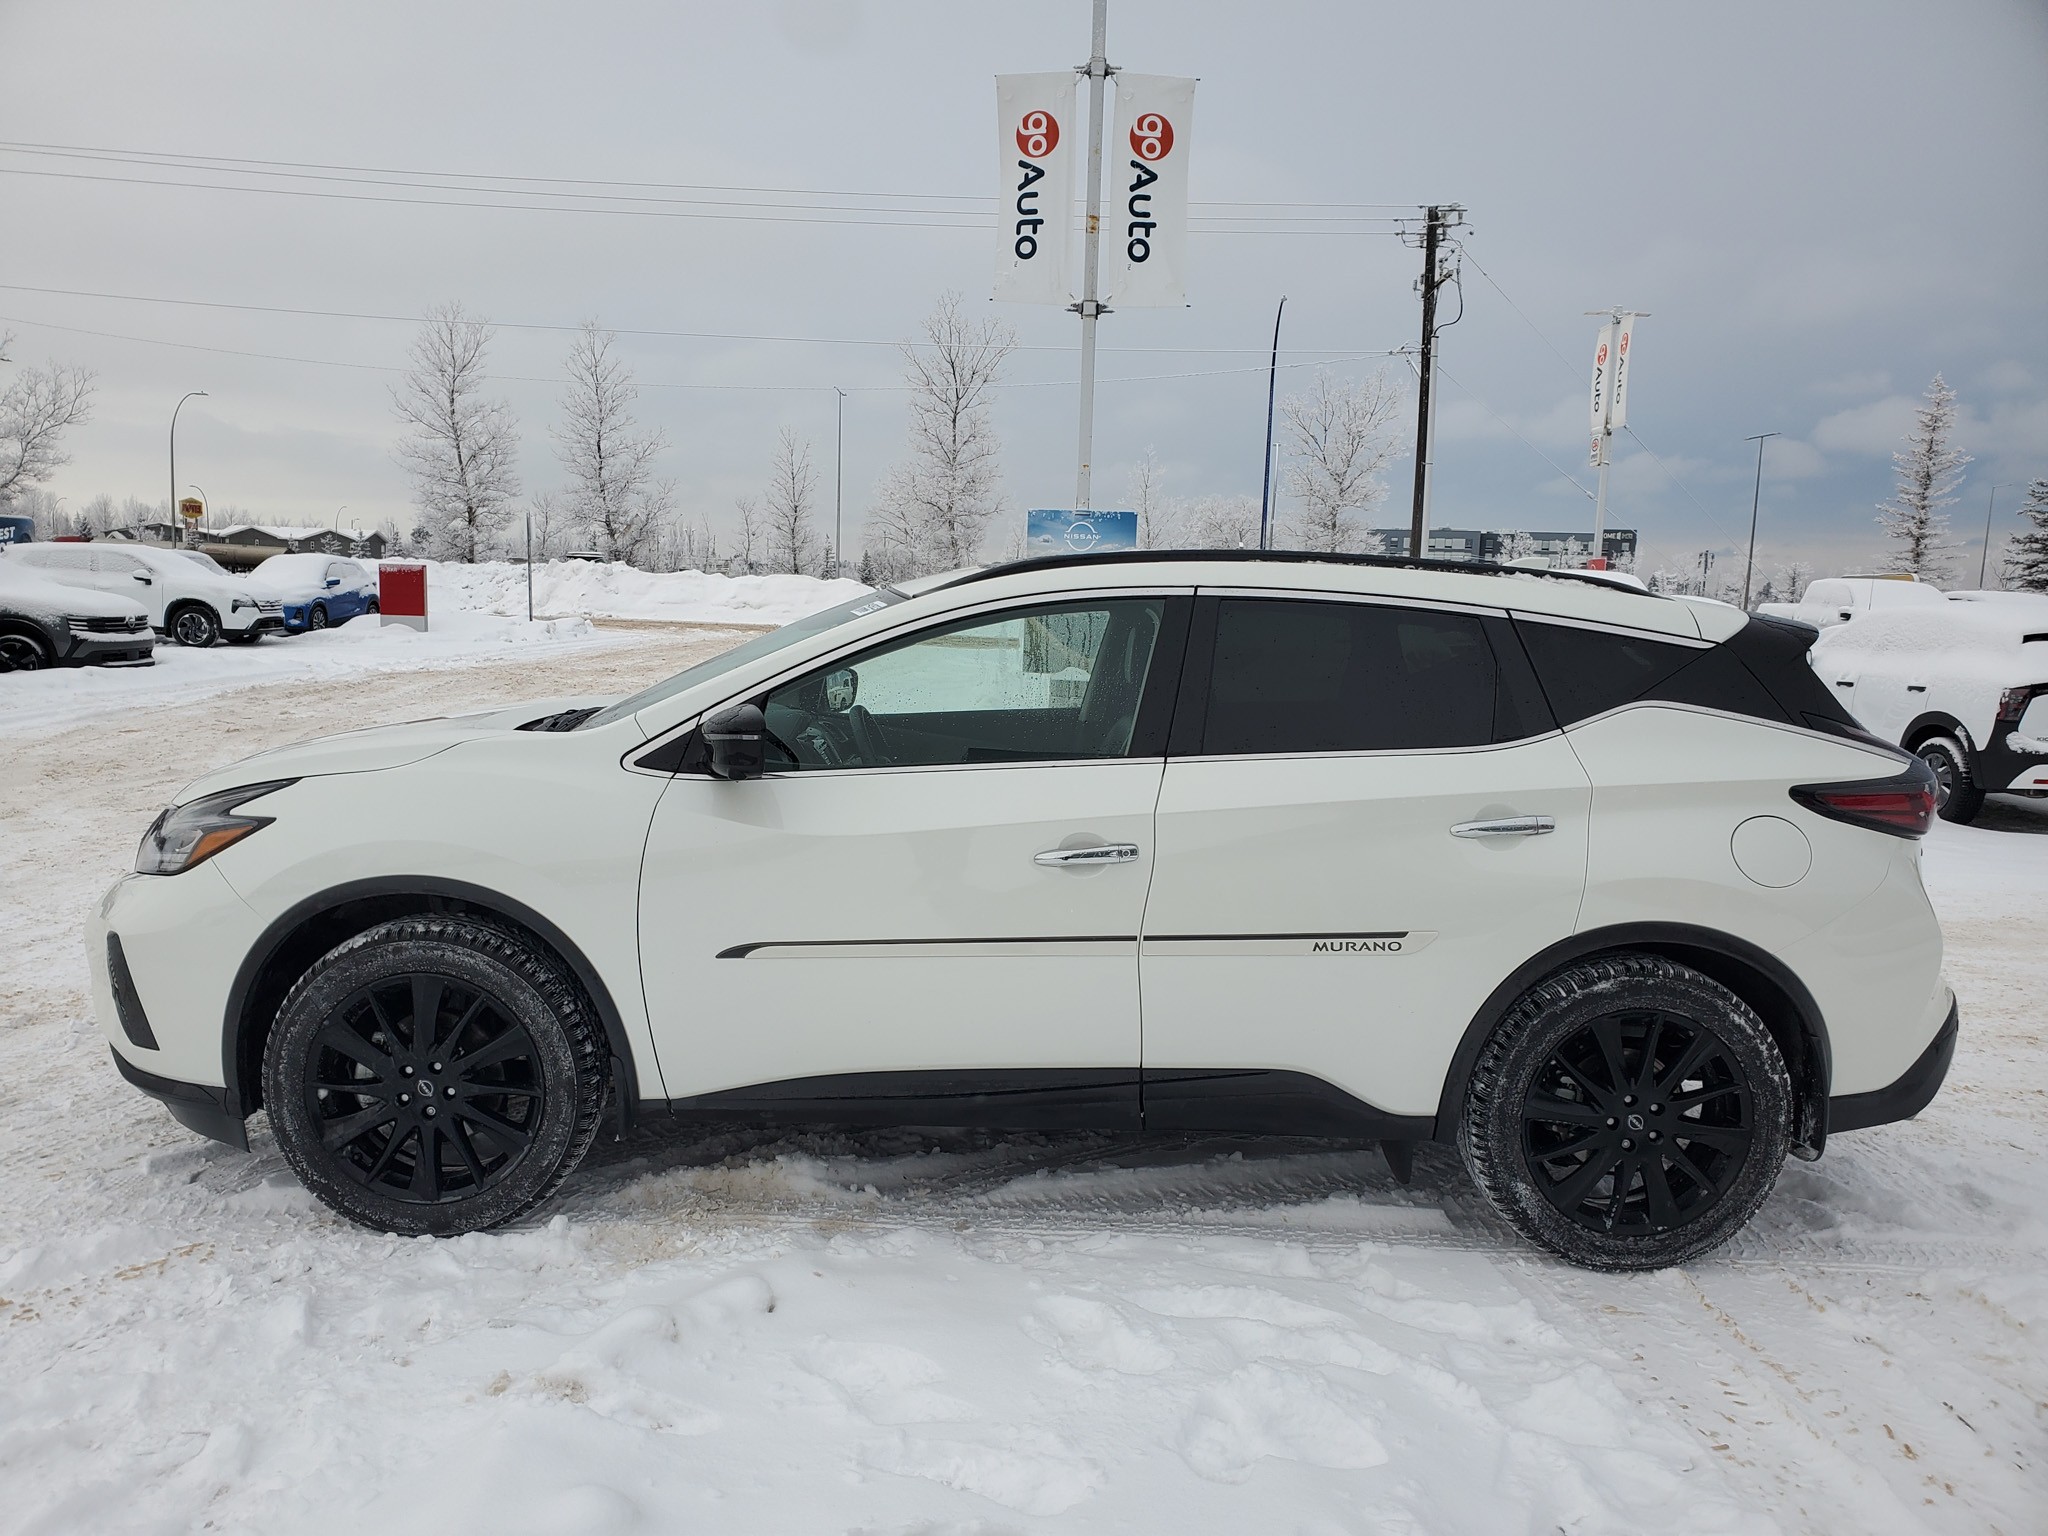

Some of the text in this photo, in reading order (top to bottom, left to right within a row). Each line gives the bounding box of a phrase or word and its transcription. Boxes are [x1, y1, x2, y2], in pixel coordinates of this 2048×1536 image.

[1015, 112, 1049, 260] go Auto
[1127, 114, 1163, 263] go Auto
[1594, 367, 1602, 412] Auto
[1616, 357, 1624, 404] Auto
[1312, 941, 1402, 952] MURANO
